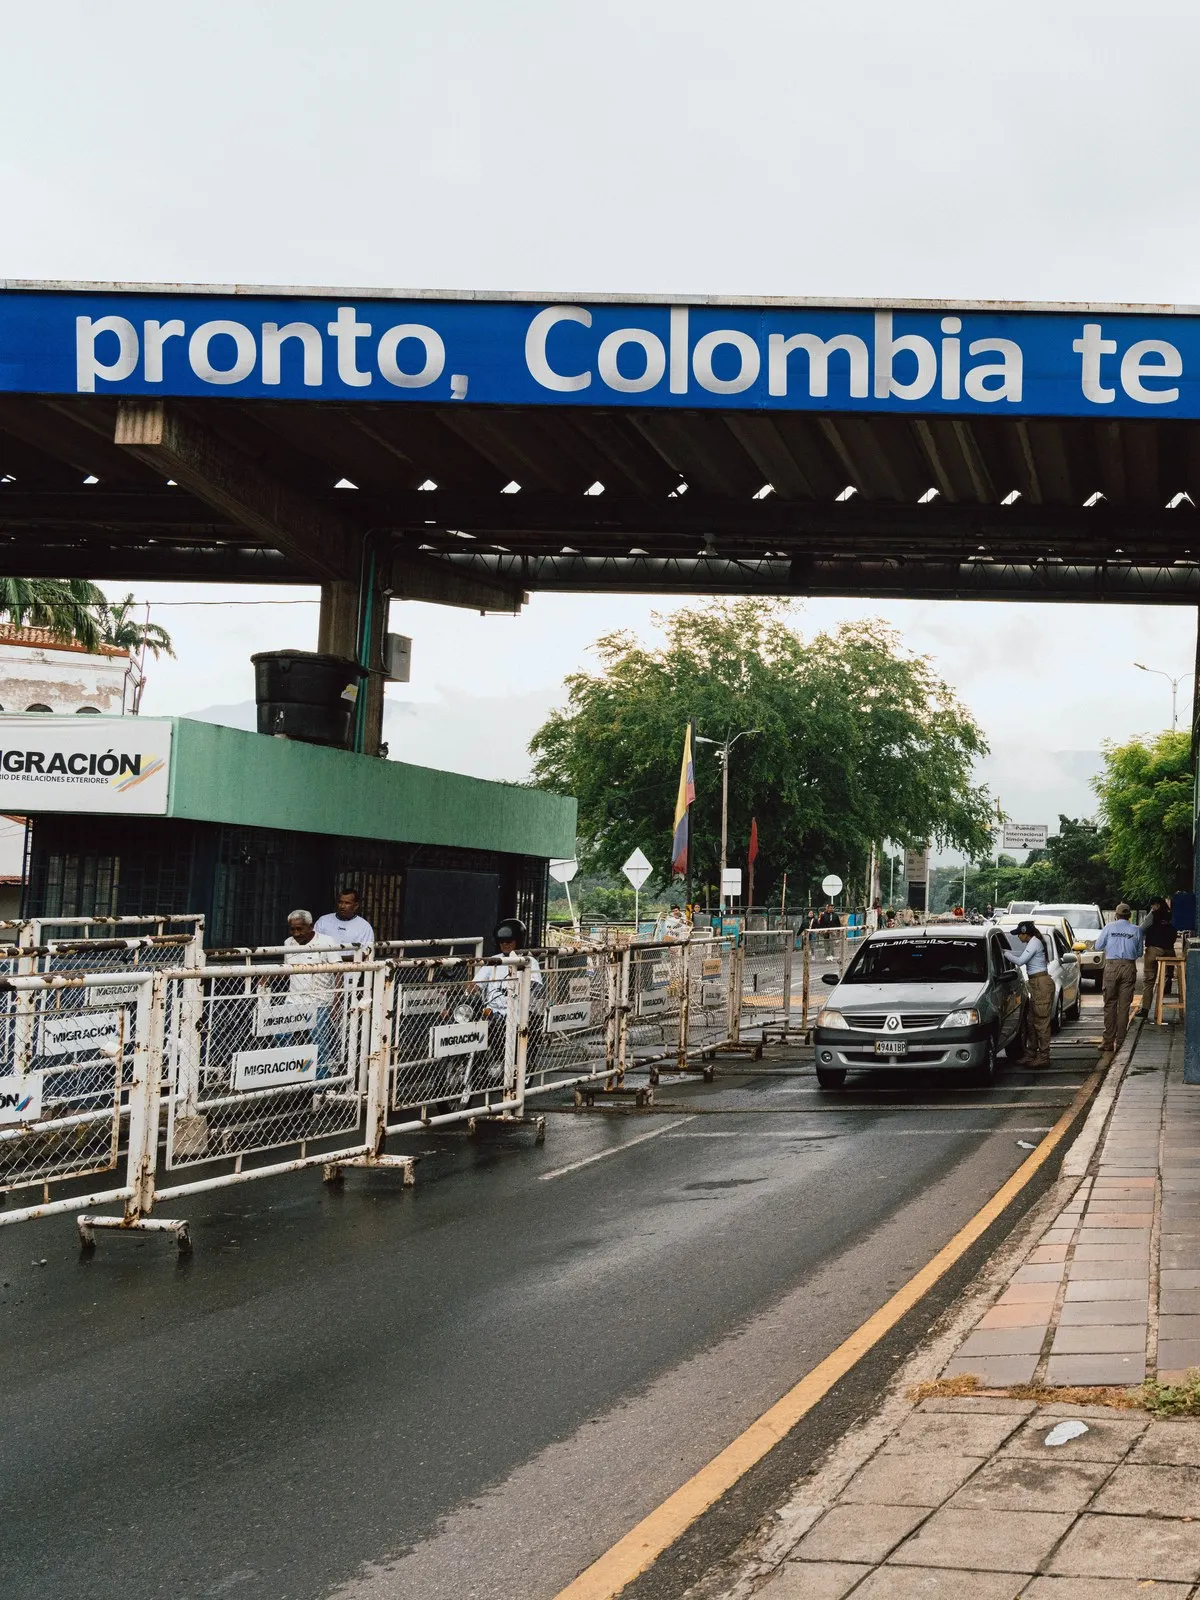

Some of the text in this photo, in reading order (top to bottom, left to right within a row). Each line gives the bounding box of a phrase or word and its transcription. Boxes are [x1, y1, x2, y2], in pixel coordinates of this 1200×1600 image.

[75, 306, 470, 400] pronto,
[524, 303, 1023, 404] Colombia
[1072, 323, 1184, 405] te
[22, 775, 65, 783] RELACIONES
[66, 776, 109, 784] EXTERIORES
[440, 1031, 480, 1047] MIGRACIÓN
